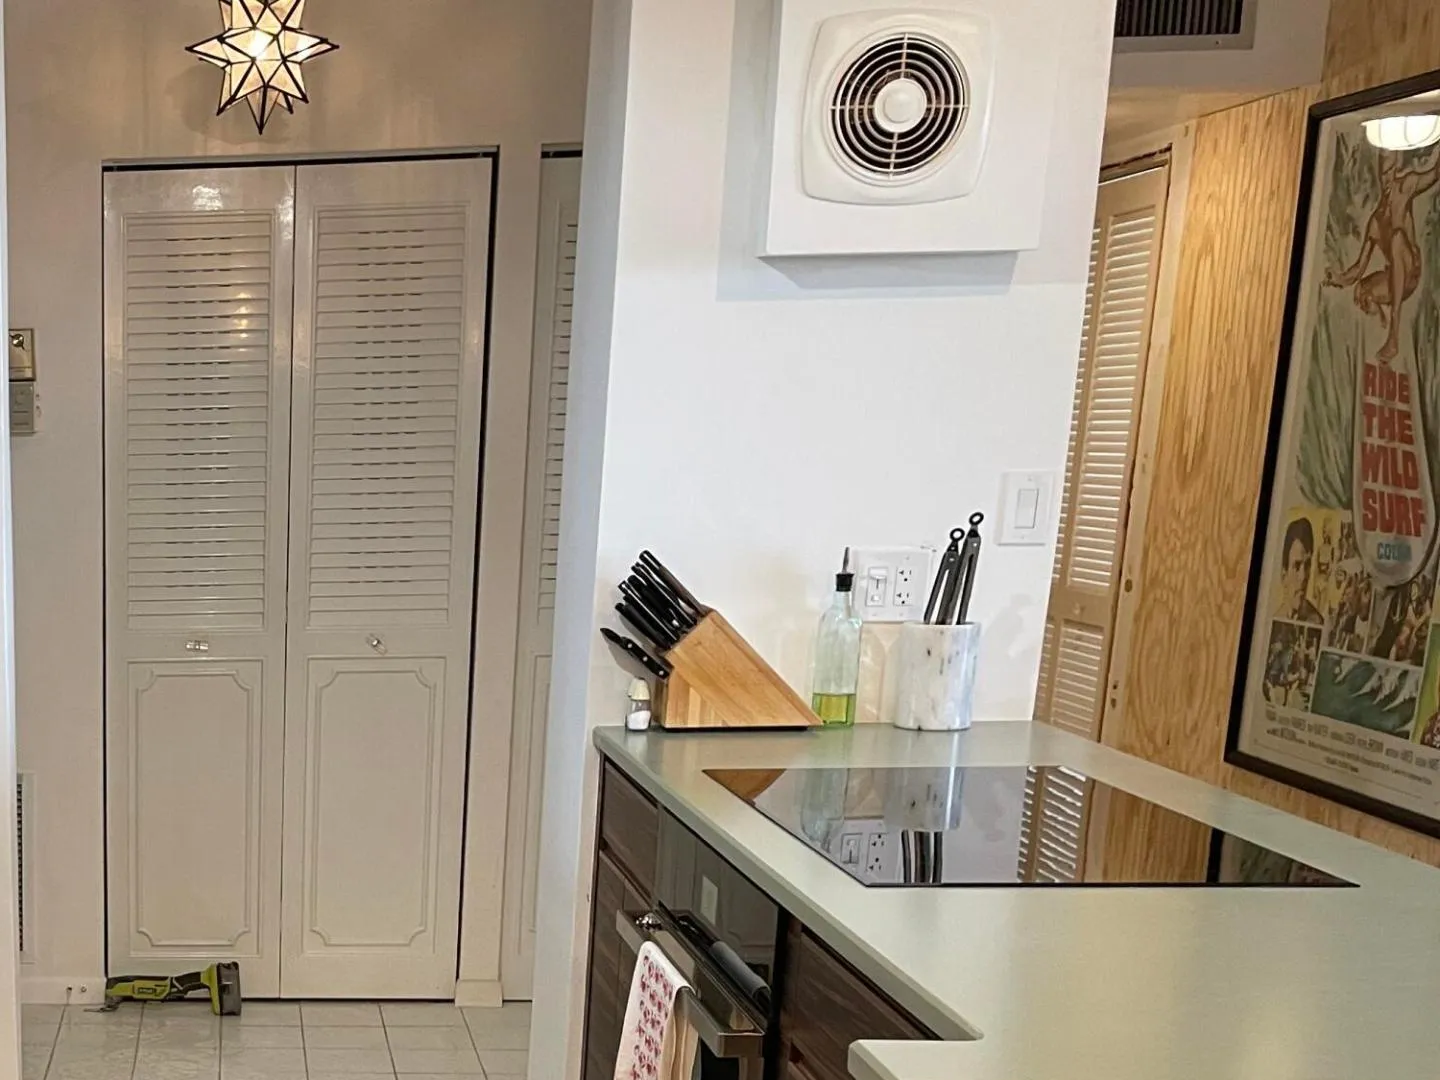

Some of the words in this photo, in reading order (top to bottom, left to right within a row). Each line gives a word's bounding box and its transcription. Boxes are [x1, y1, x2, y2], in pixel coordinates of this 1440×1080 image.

[1364, 362, 1410, 404] RIDE
[1363, 401, 1414, 445] THE
[1362, 442, 1419, 490] WILD
[1363, 488, 1426, 537] SURF
